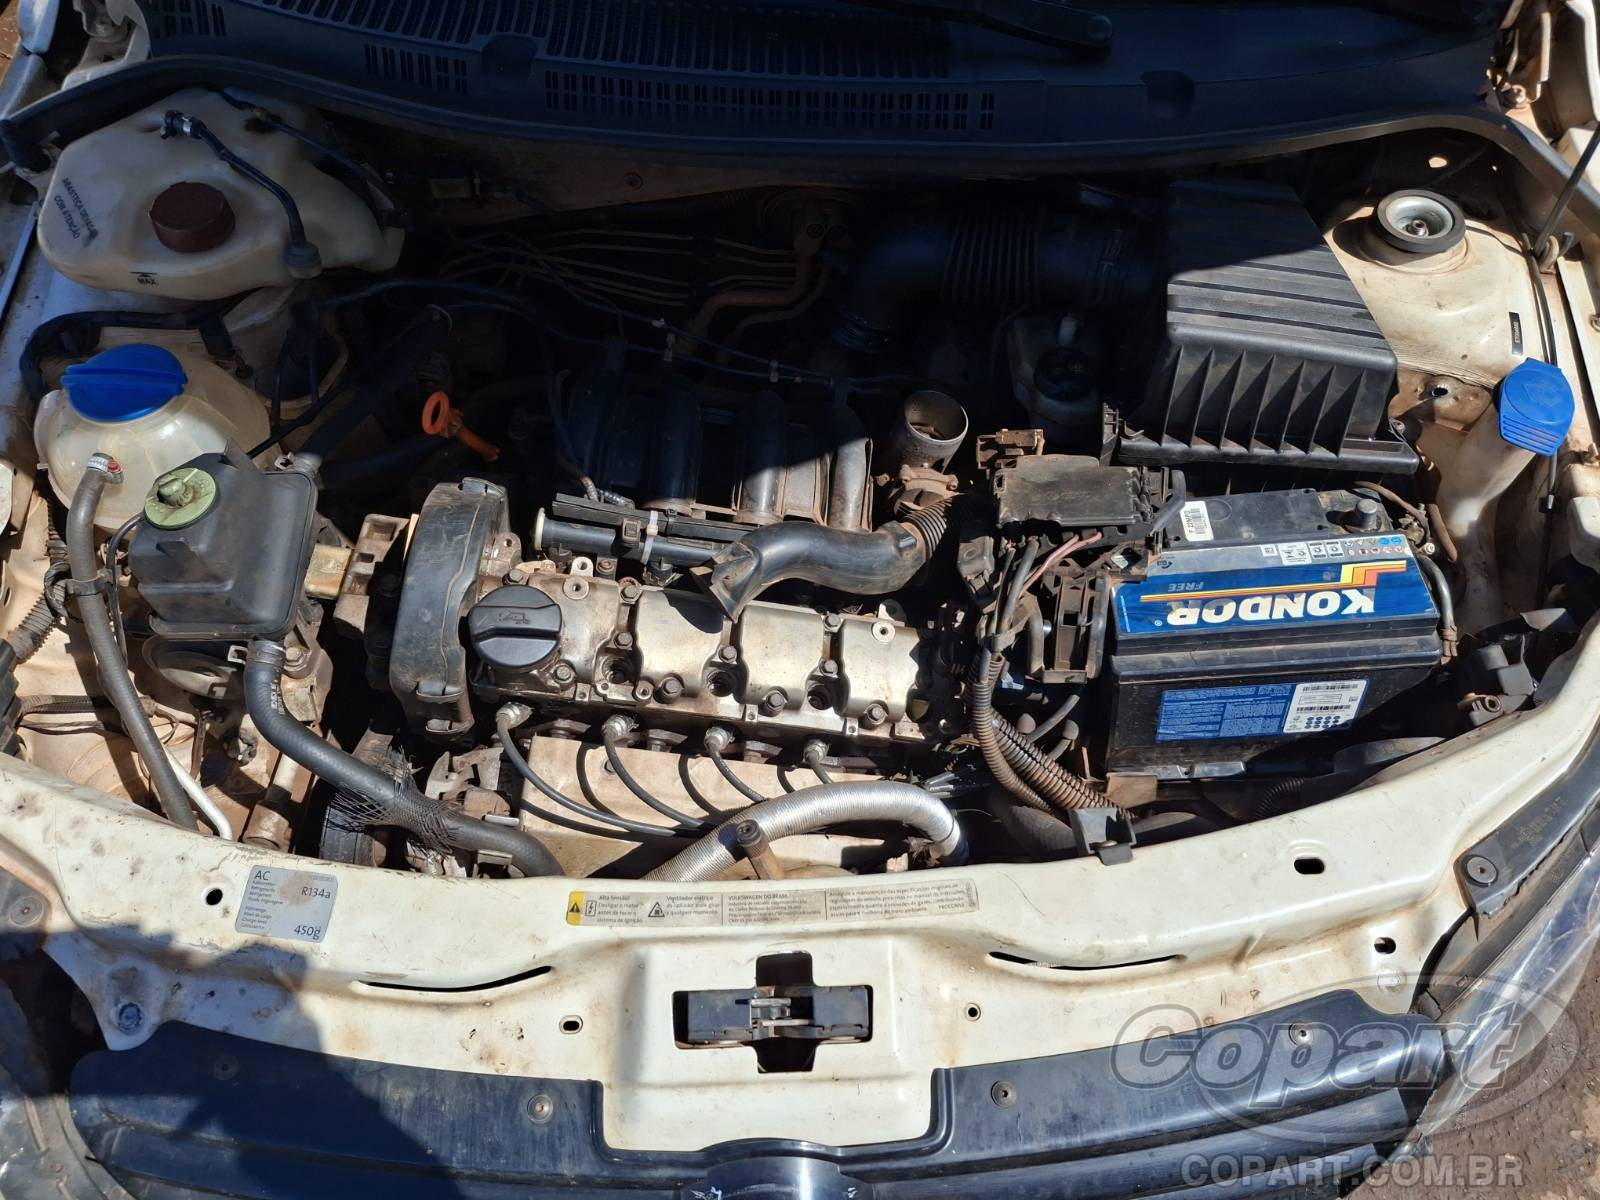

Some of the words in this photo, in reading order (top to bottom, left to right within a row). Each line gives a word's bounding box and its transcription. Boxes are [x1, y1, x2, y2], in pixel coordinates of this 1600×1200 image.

[1167, 581, 1205, 594] FREE
[1166, 588, 1376, 626] KONDOR
[254, 870, 271, 880] AC
[301, 886, 331, 899] R134a
[294, 925, 322, 940] 450g
